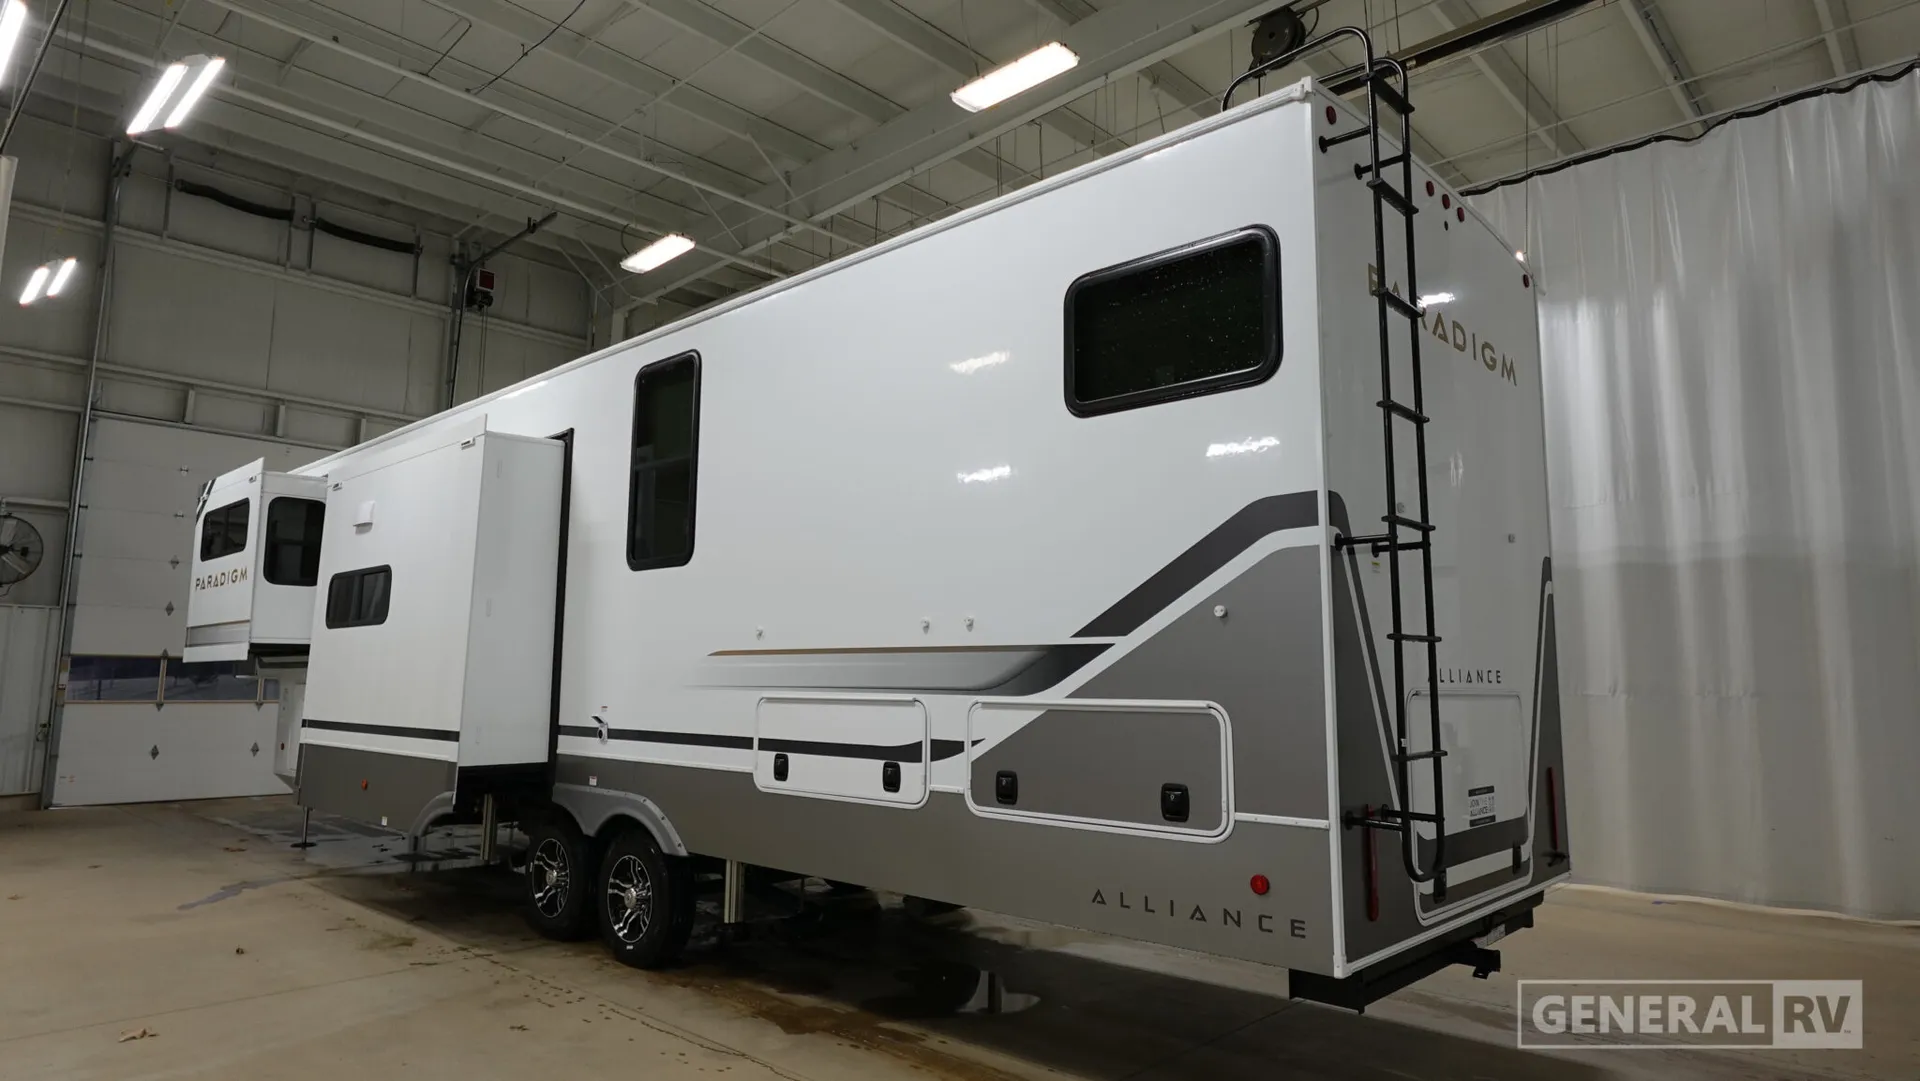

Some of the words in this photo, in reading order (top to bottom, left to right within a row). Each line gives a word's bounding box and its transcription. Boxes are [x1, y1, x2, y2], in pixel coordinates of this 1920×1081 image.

[195, 565, 248, 591] PARADIGM
[1428, 668, 1503, 684] LLIANCE
[1091, 889, 1306, 939] ALLIANCE
